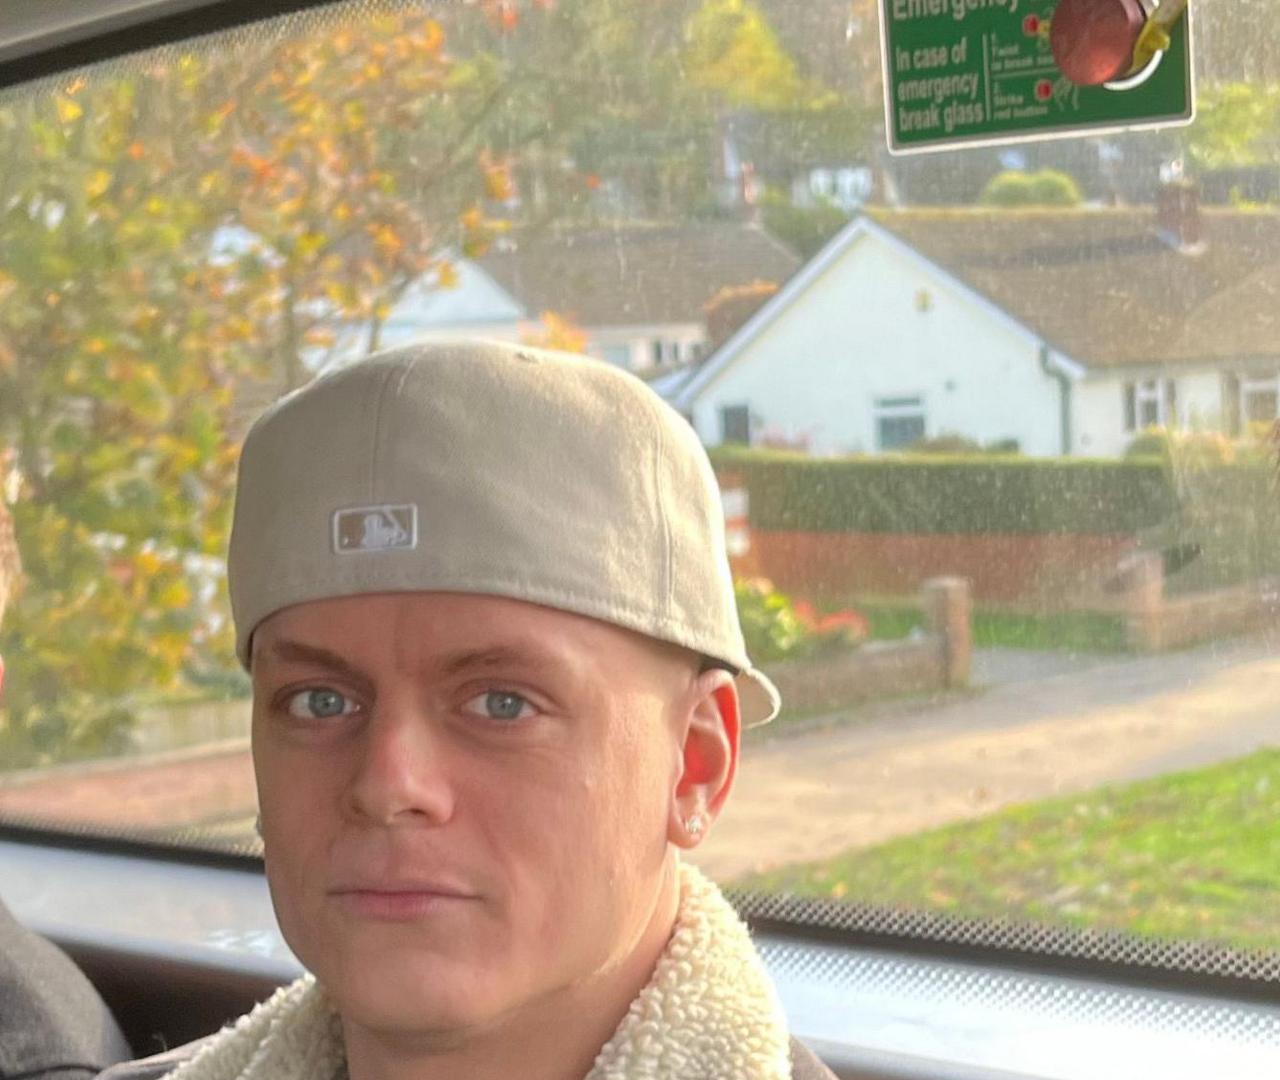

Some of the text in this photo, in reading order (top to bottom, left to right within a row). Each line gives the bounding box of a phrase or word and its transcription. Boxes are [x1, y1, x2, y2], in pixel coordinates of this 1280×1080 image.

[893, 0, 1019, 20] Emerg
[913, 45, 949, 70] case
[951, 36, 967, 64] of
[897, 72, 979, 103] emergency
[898, 103, 940, 132] break
[944, 99, 984, 132] glass
